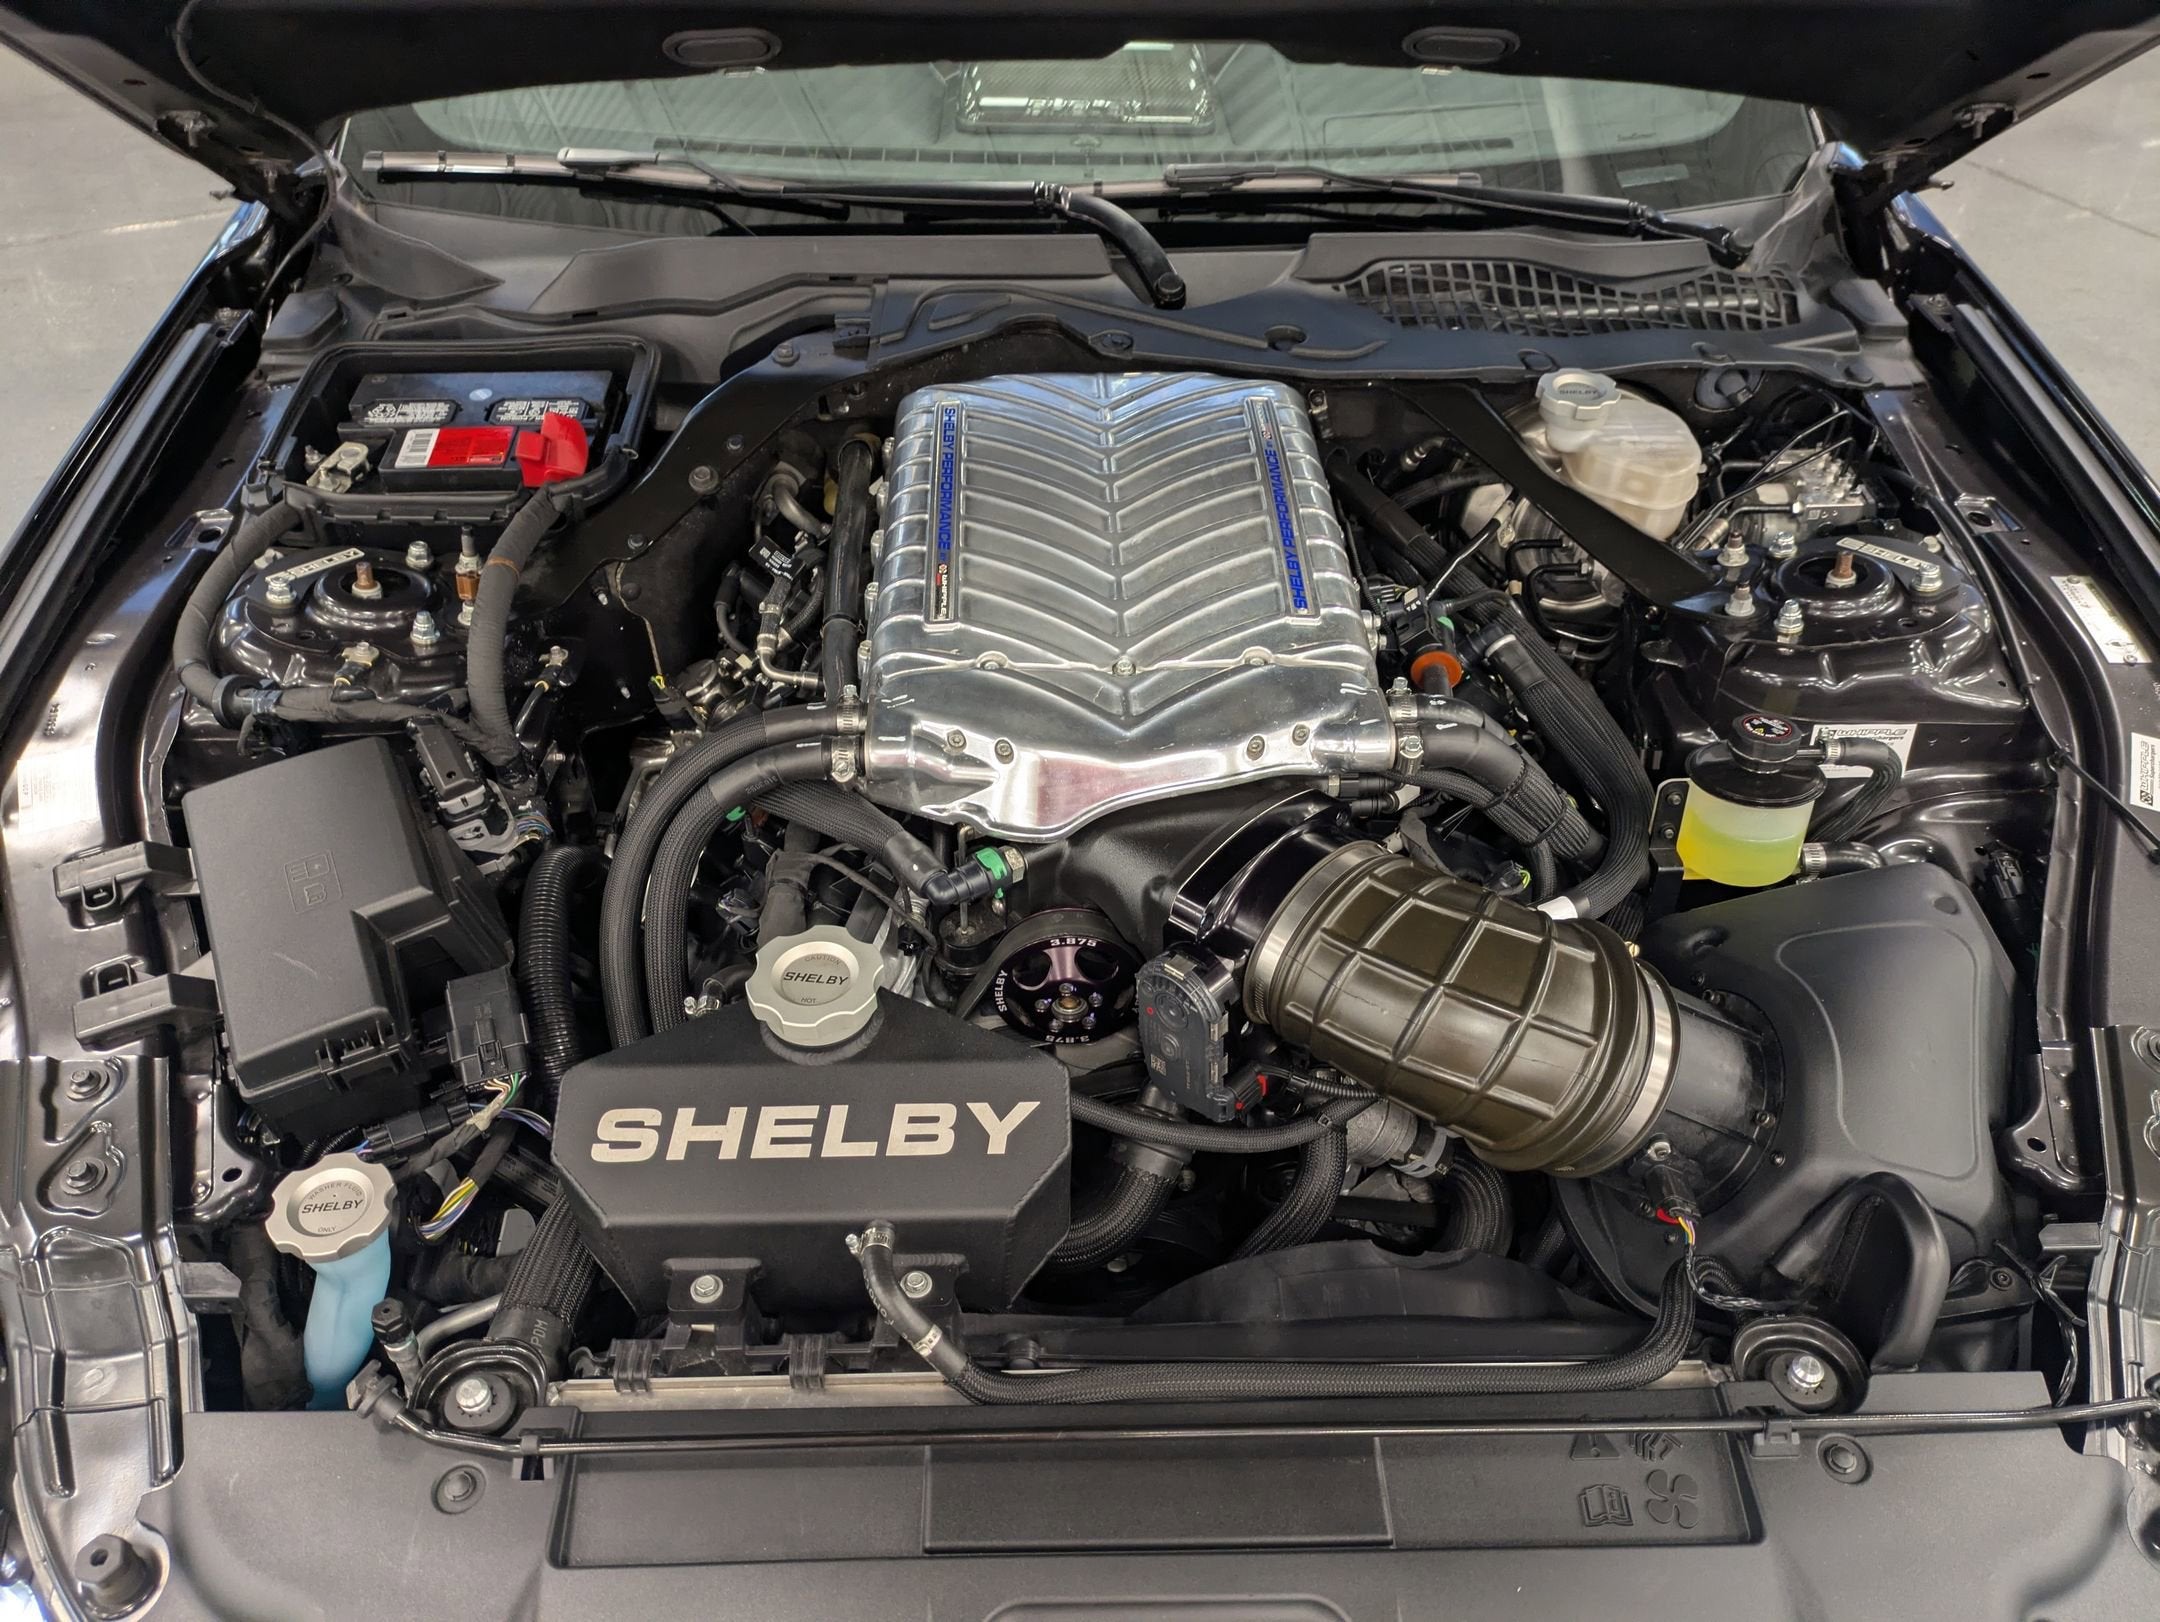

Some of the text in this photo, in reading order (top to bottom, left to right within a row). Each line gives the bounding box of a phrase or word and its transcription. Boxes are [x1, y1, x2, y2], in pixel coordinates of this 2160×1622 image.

[943, 407, 956, 450] SHELBY
[938, 452, 954, 550] PERFORMANCE
[1264, 448, 1297, 549] PERFORMANCE
[940, 574, 948, 616] WHIPPLE
[1285, 551, 1308, 609] SHELBY
[1837, 728, 1909, 737] WHIPPLE
[2141, 740, 2150, 791] WHIPPLE
[804, 954, 841, 966] CAUTION
[1050, 937, 1098, 947] 3.875
[783, 971, 849, 986] SHELBY
[994, 969, 1009, 1013] SHELBY
[1045, 1034, 1090, 1043] 3.875
[590, 1101, 1041, 1163] SHELBY
[301, 1199, 364, 1214] SHELBY
[308, 1182, 363, 1201] WASHER FLUID
